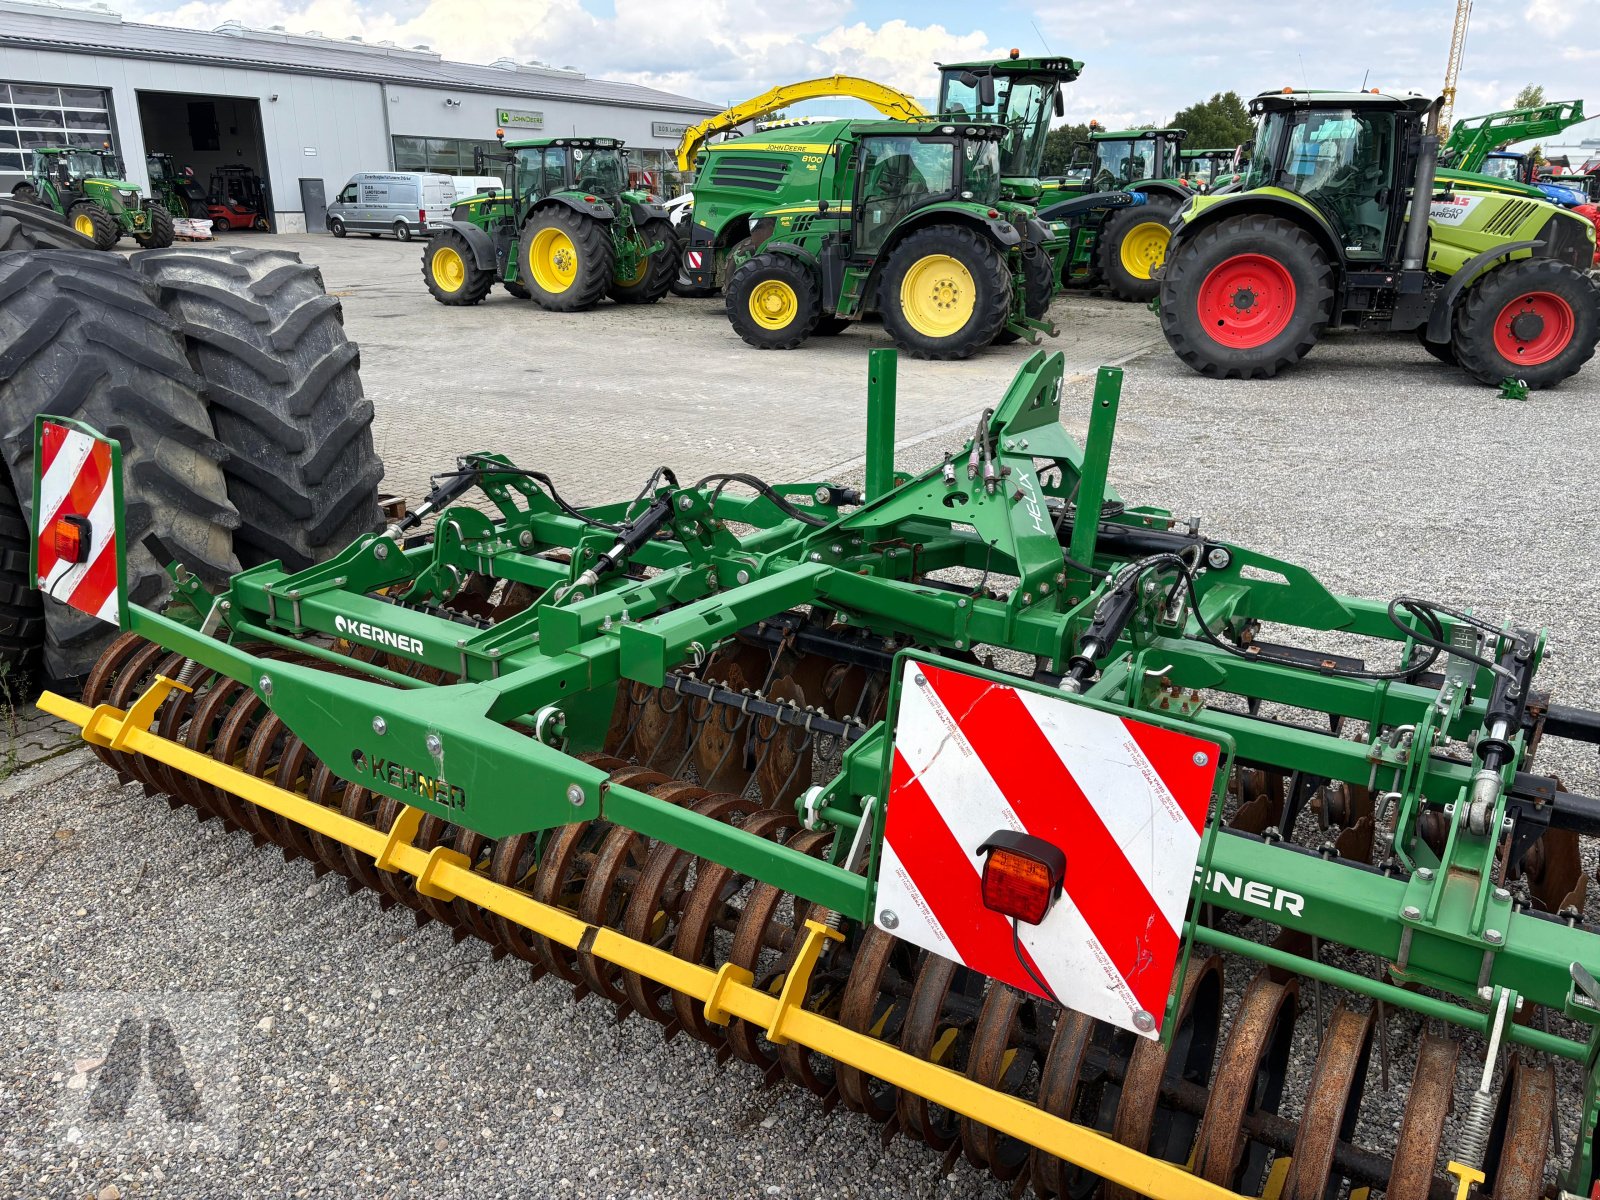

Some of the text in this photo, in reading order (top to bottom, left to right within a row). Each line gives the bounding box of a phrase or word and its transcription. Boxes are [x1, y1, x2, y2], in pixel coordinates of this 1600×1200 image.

[801, 155, 823, 164] 8100
[1429, 211, 1459, 219] ARION
[1442, 206, 1464, 214] 640
[1016, 467, 1047, 535] HELIX
[347, 618, 424, 656] KERNER
[371, 754, 466, 812] KERNER
[1141, 769, 1153, 785] GEKA
[1153, 777, 1165, 794] GEKA
[1194, 865, 1305, 917] RNER
